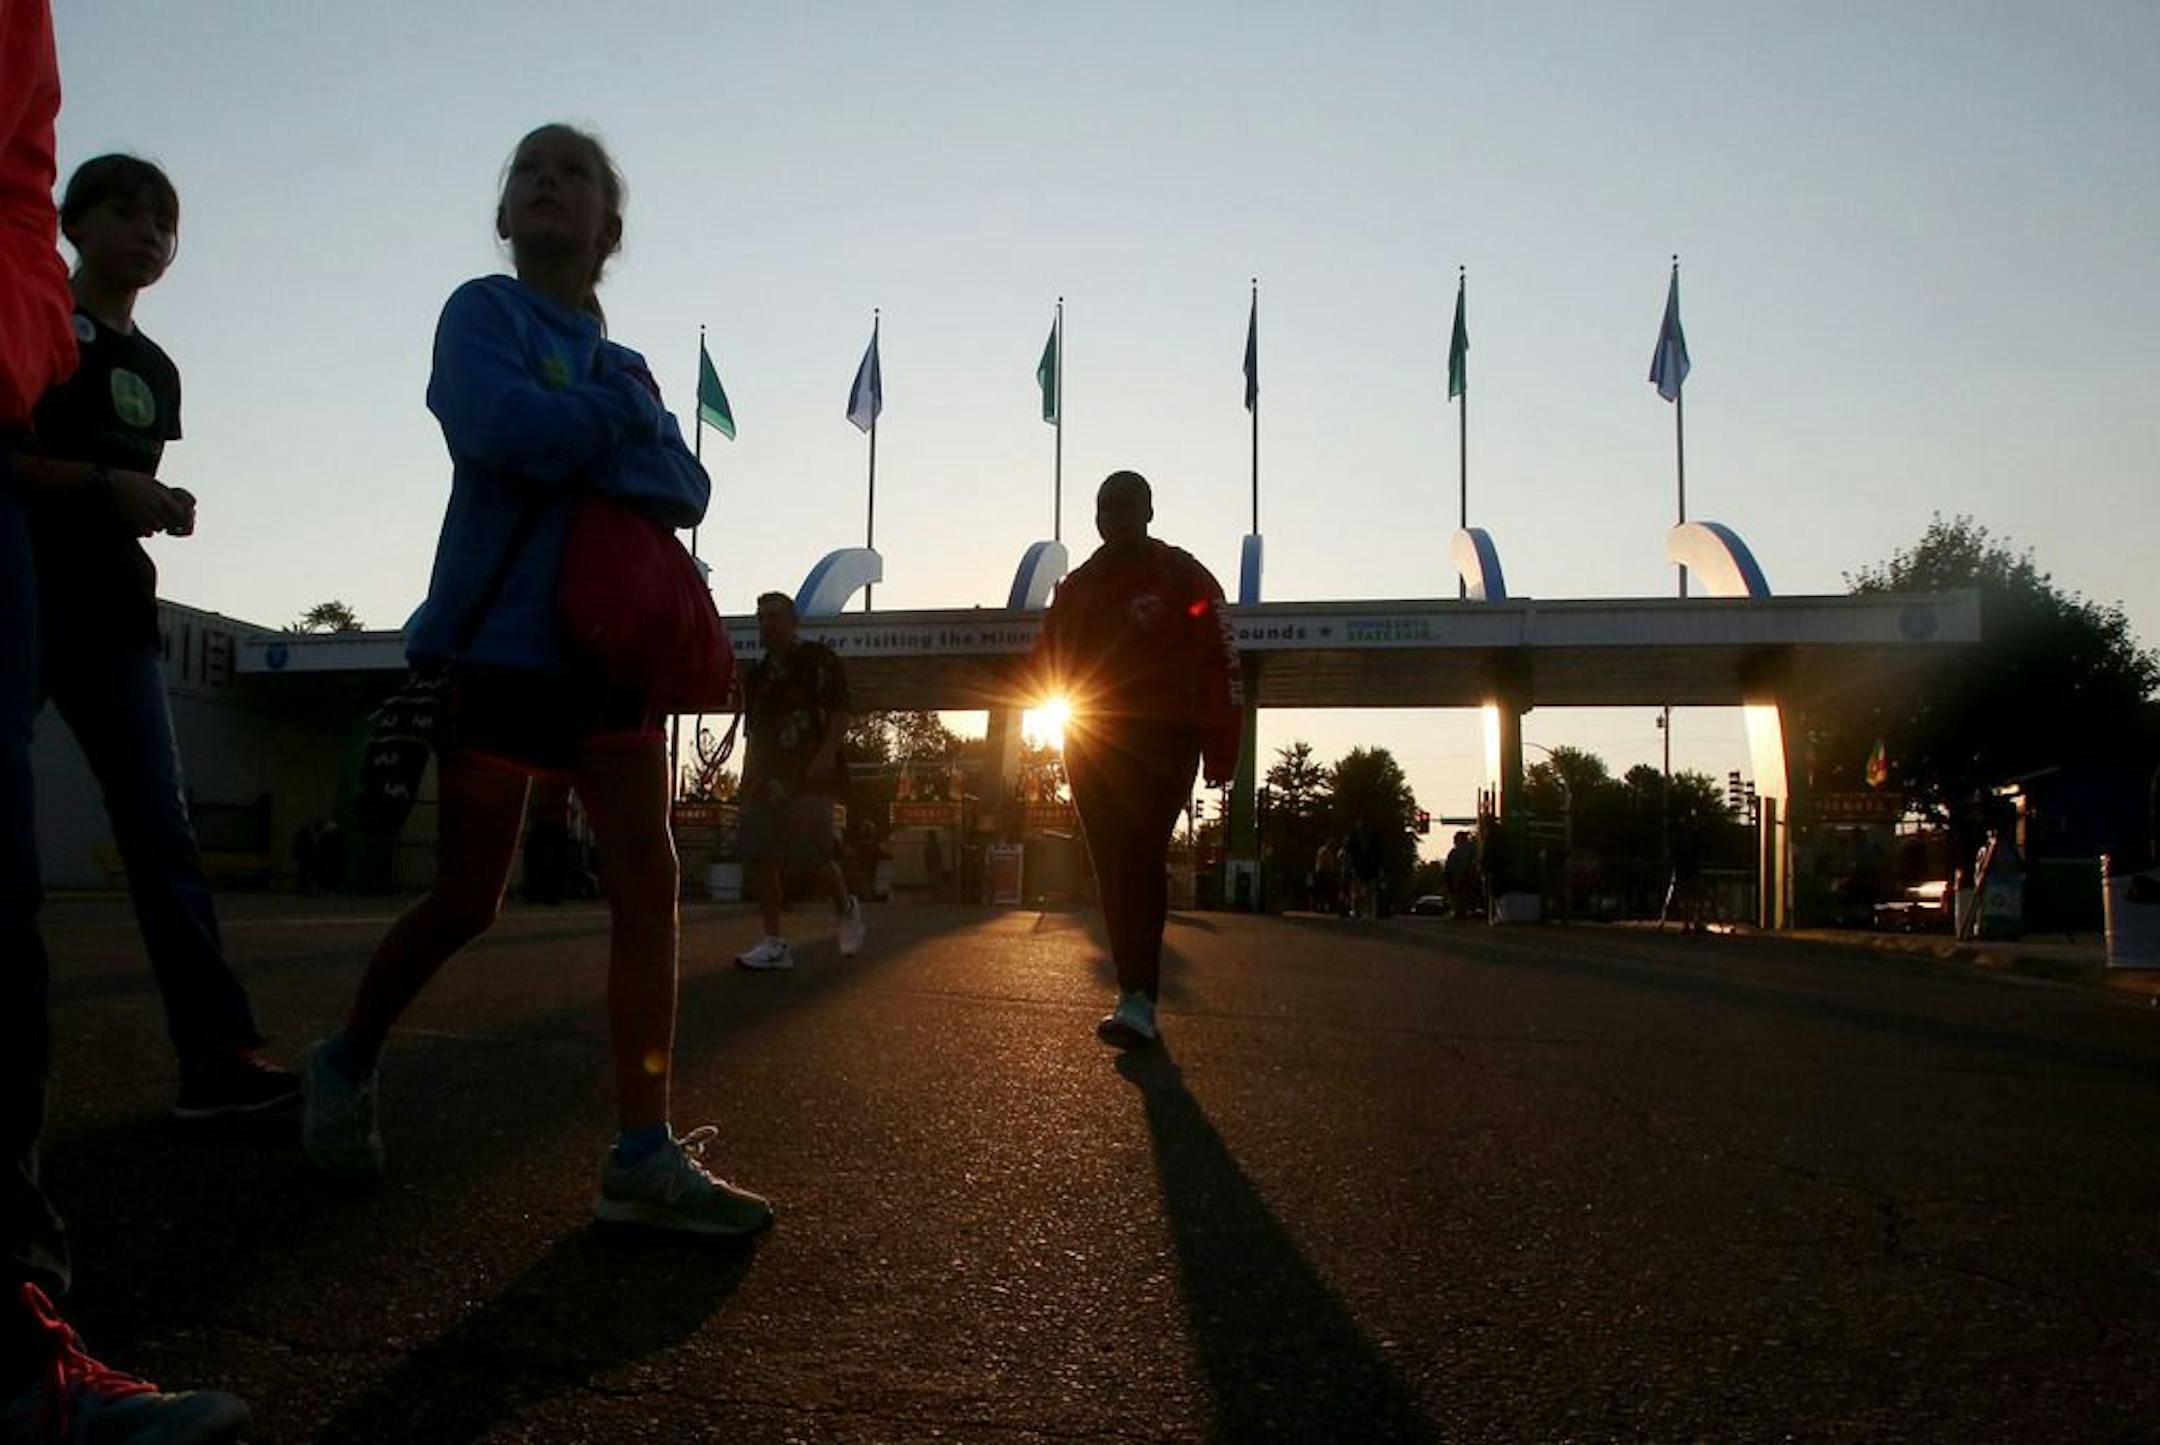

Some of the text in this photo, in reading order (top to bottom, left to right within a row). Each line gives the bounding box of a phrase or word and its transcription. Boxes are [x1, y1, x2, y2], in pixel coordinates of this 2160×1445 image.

[818, 633, 848, 648] for
[852, 631, 932, 649] visiting
[940, 629, 973, 646] the
[980, 628, 1034, 645] Minn
[1238, 623, 1306, 640] ounds
